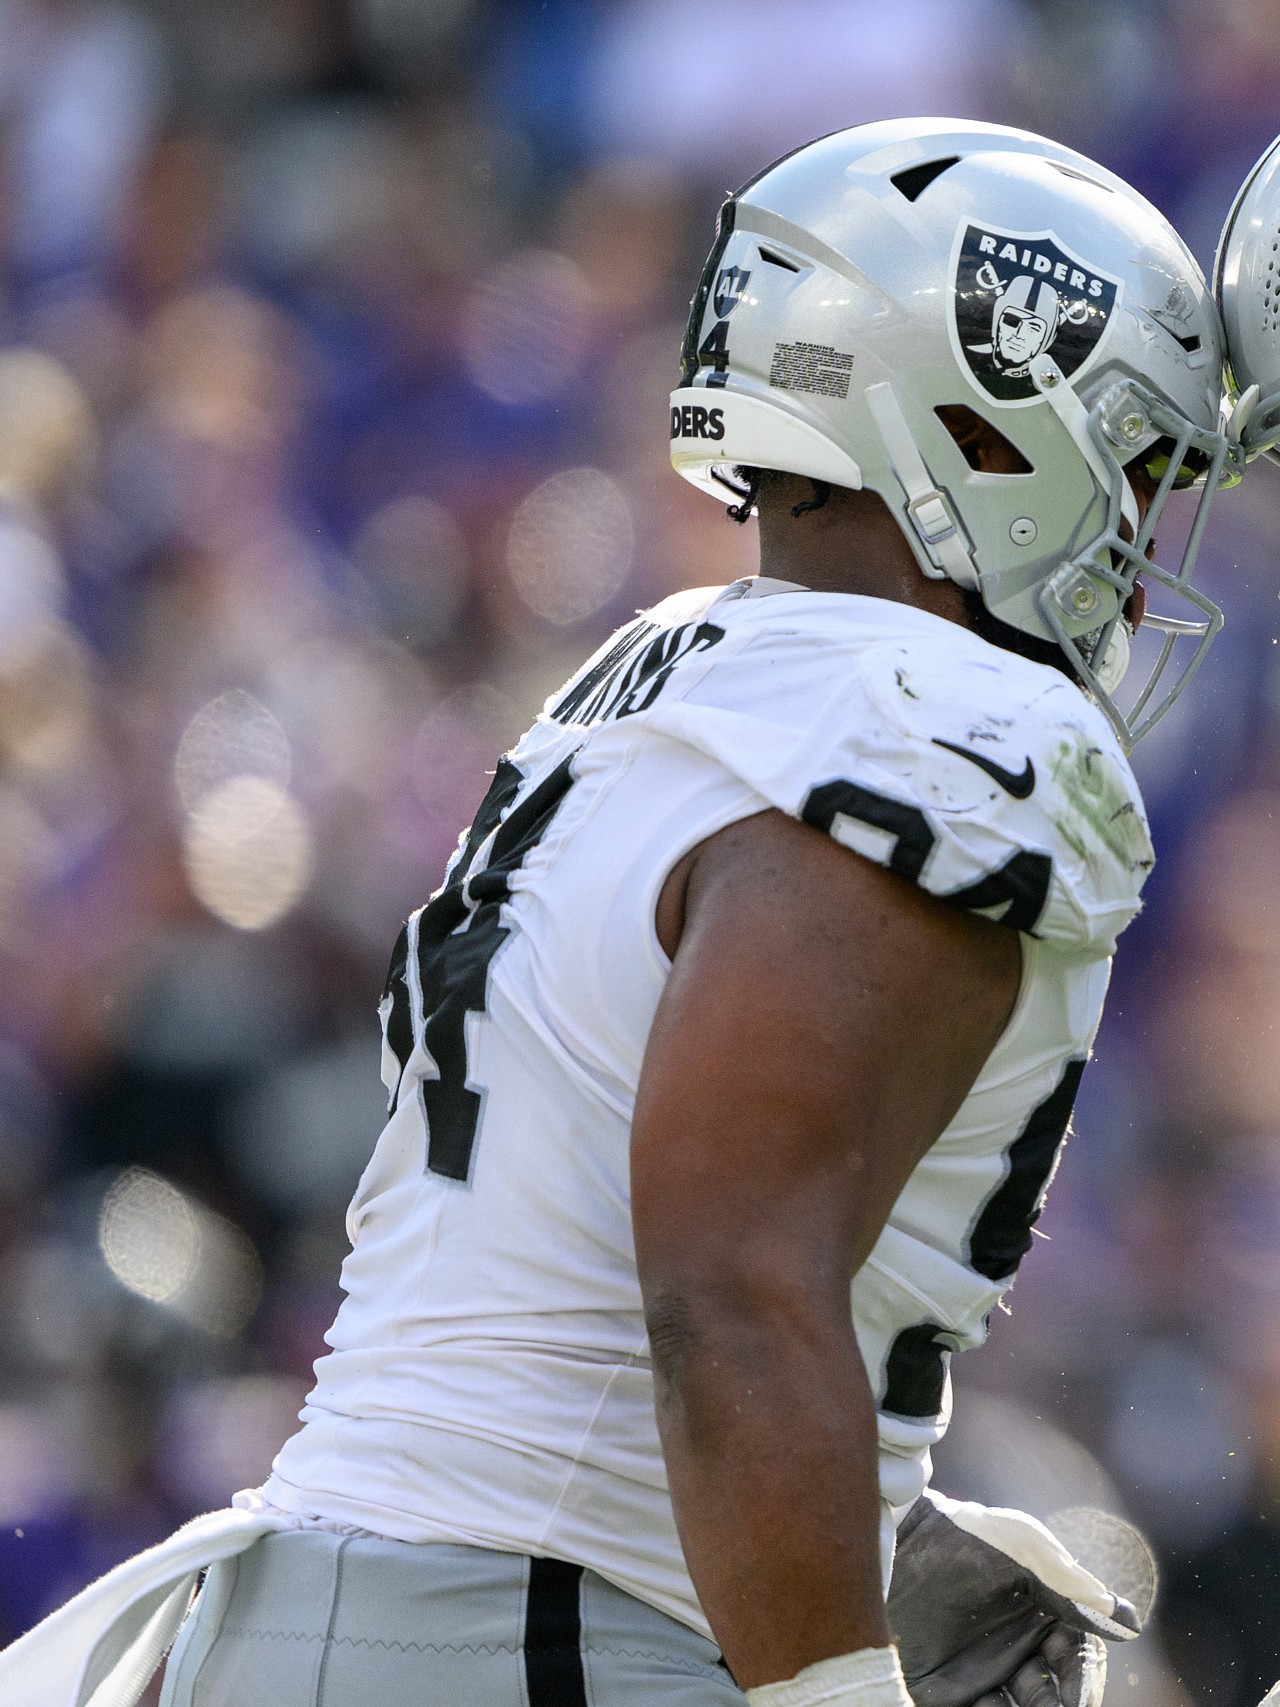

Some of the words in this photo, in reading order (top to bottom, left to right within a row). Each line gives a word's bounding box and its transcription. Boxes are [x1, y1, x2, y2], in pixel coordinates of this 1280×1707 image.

[979, 235, 1103, 297] RAIDERS
[716, 276, 744, 300] AL
[795, 341, 835, 352] WARNING
